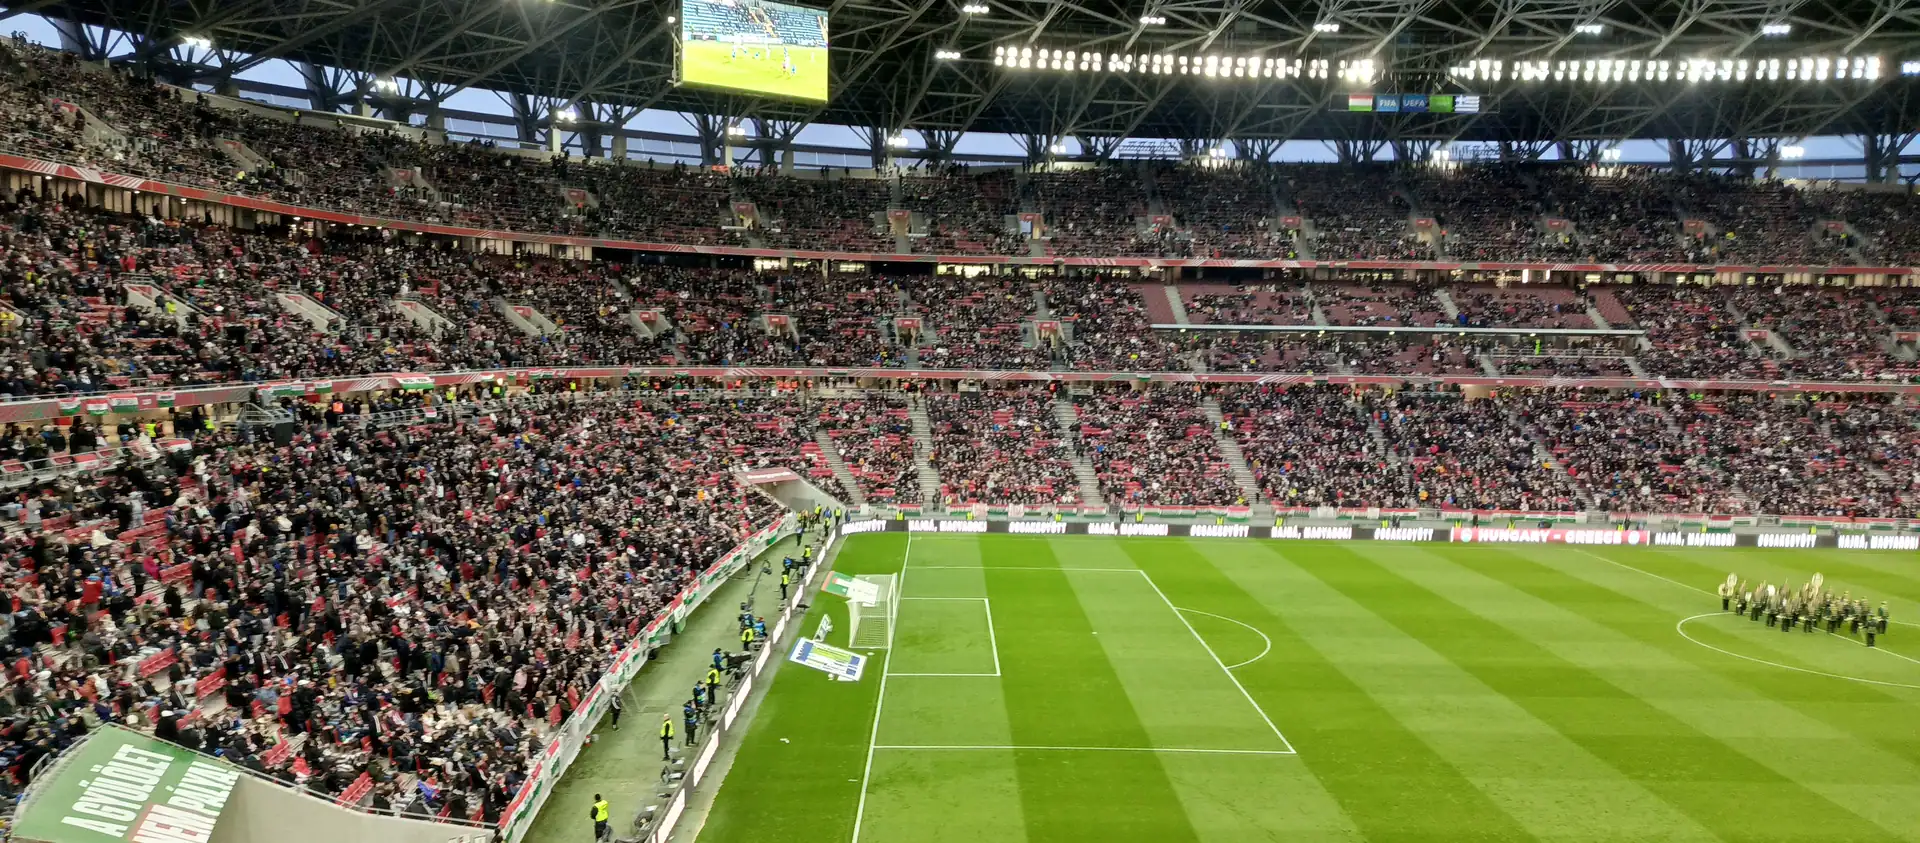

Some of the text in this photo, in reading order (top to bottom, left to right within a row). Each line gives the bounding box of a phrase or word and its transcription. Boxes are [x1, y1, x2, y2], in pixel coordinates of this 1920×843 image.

[1380, 99, 1396, 107] FIFA
[1403, 99, 1425, 107] UEFA
[1477, 528, 1550, 544] HUNGARY
[1564, 529, 1622, 545] GREECE
[61, 743, 175, 838] A GYŰLÖLET
[132, 761, 241, 843] NEM PÁLYA!
